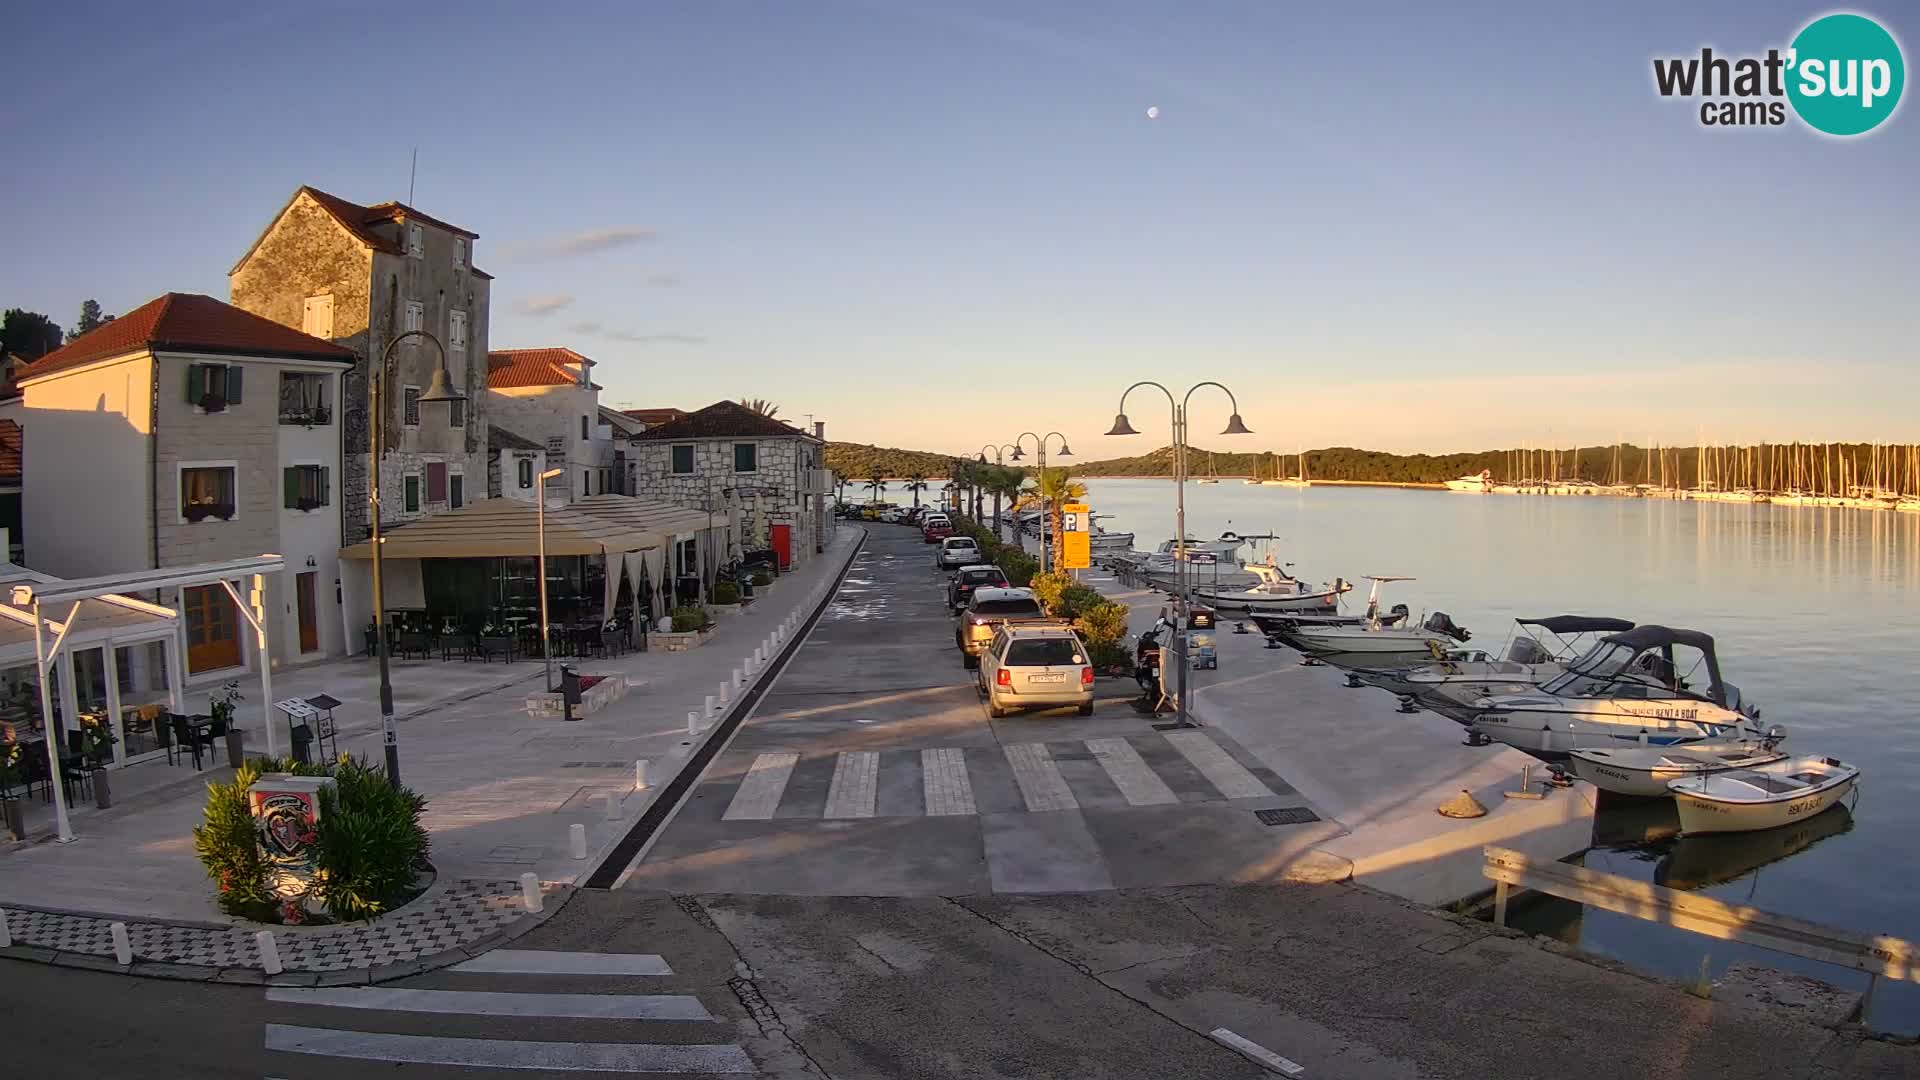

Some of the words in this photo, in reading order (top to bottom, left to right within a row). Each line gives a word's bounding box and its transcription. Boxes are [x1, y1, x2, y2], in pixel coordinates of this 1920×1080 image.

[1655, 708, 1674, 719] RENT
[1674, 709, 1679, 719] A
[1681, 709, 1698, 719] BOAT
